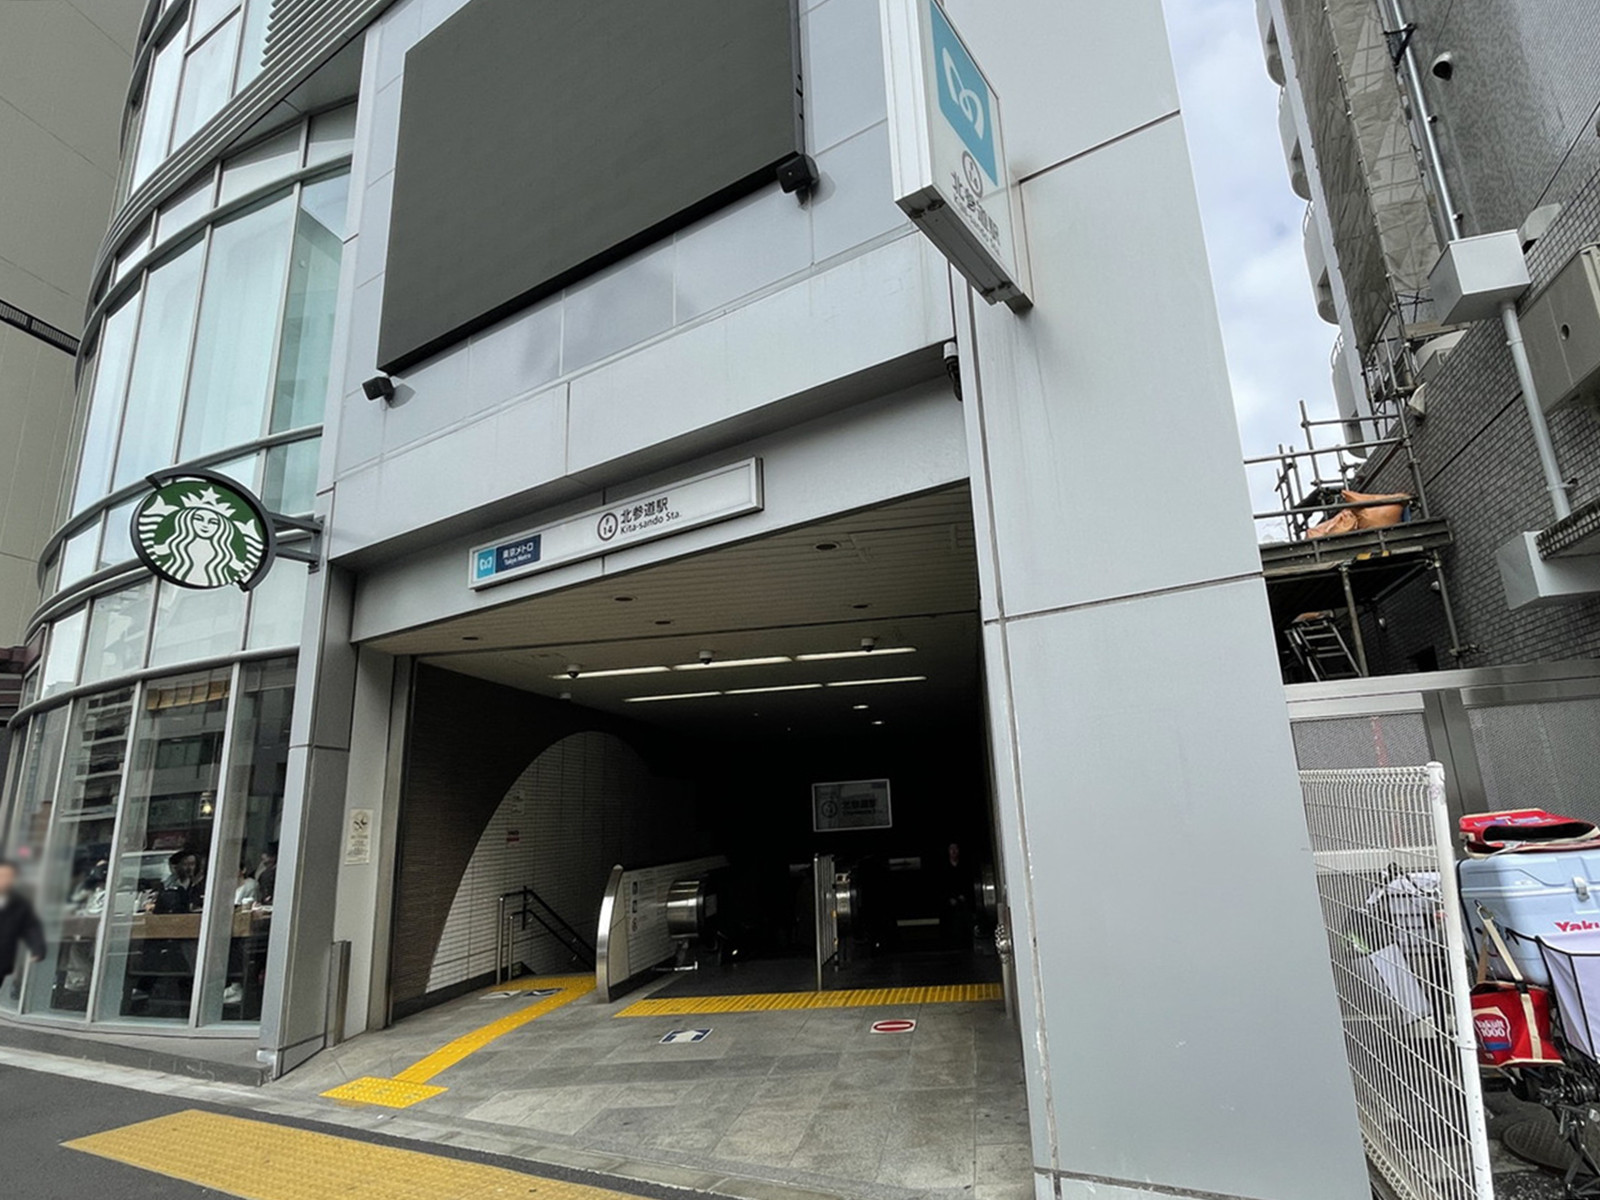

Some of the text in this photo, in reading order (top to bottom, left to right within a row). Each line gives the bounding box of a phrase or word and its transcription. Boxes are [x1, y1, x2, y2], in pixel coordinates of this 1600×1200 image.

[620, 497, 669, 524] 北参道駅
[603, 525, 613, 535] 14
[620, 511, 682, 534] Kita-sando Sta.
[503, 542, 534, 558] 東京メトロ
[1480, 1028, 1505, 1038] 1000
